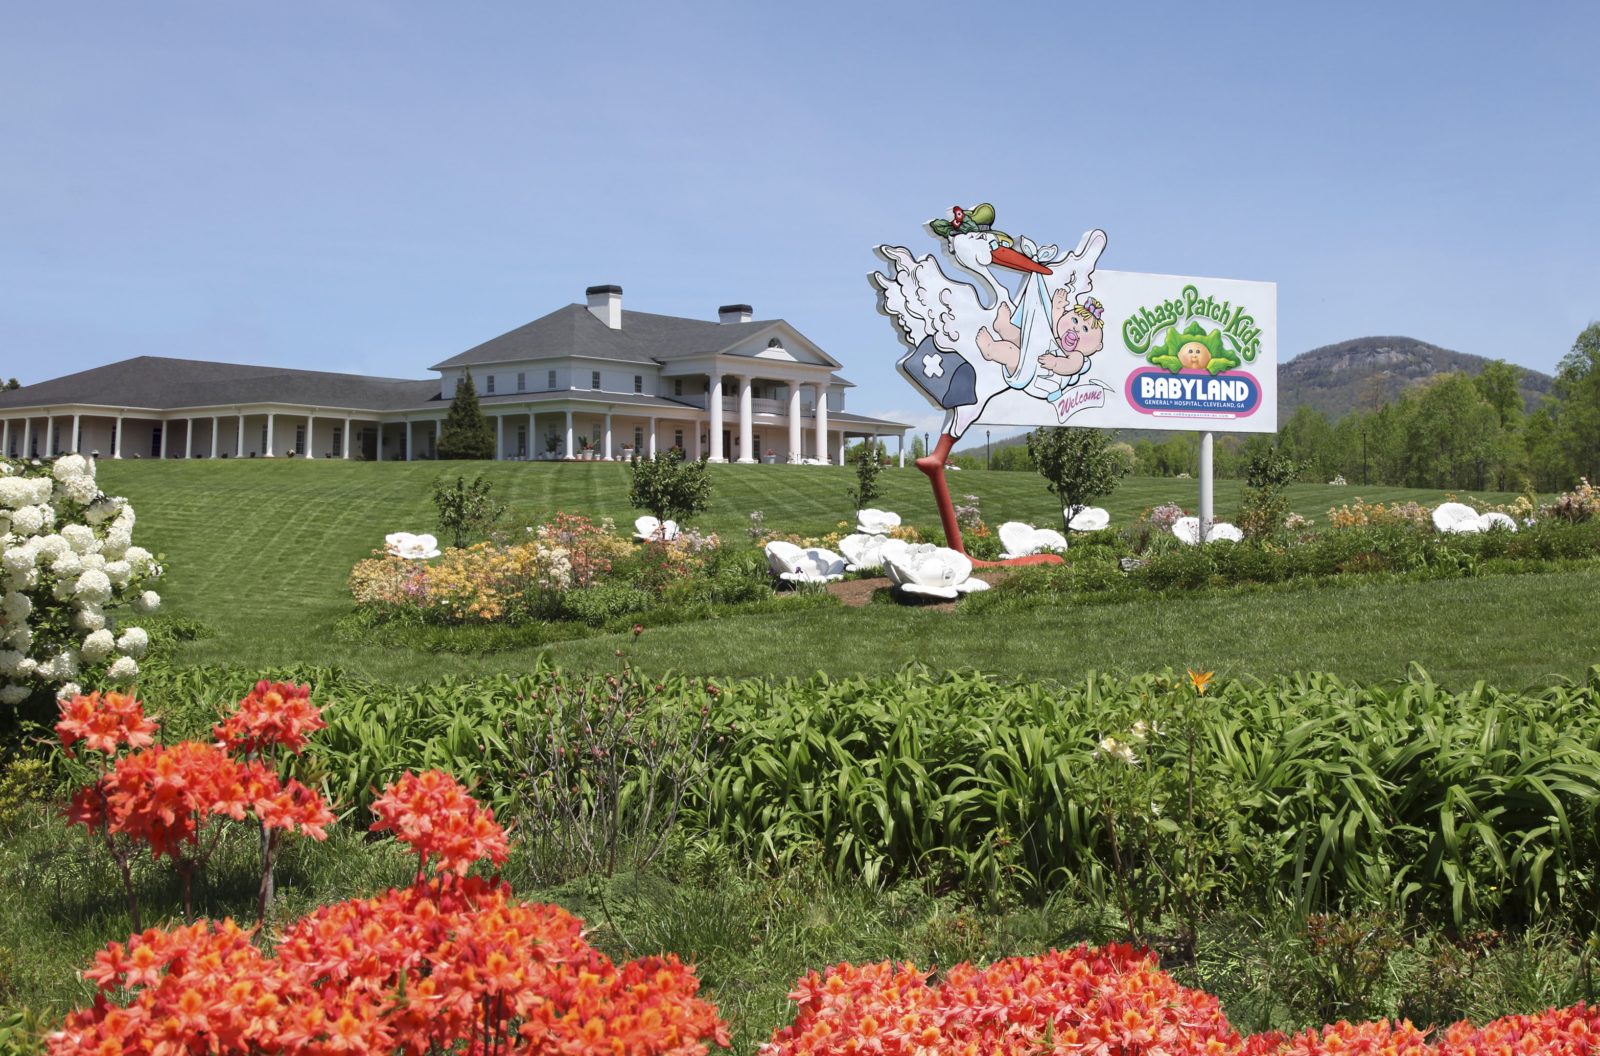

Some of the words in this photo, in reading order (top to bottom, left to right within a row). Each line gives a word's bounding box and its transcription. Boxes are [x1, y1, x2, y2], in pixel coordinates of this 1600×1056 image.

[1122, 299, 1184, 354] Cabbage
[1182, 284, 1230, 322] Patch
[1223, 306, 1261, 362] Kids
[1141, 376, 1249, 402] BABYLAND
[1058, 390, 1102, 416] Welcome
